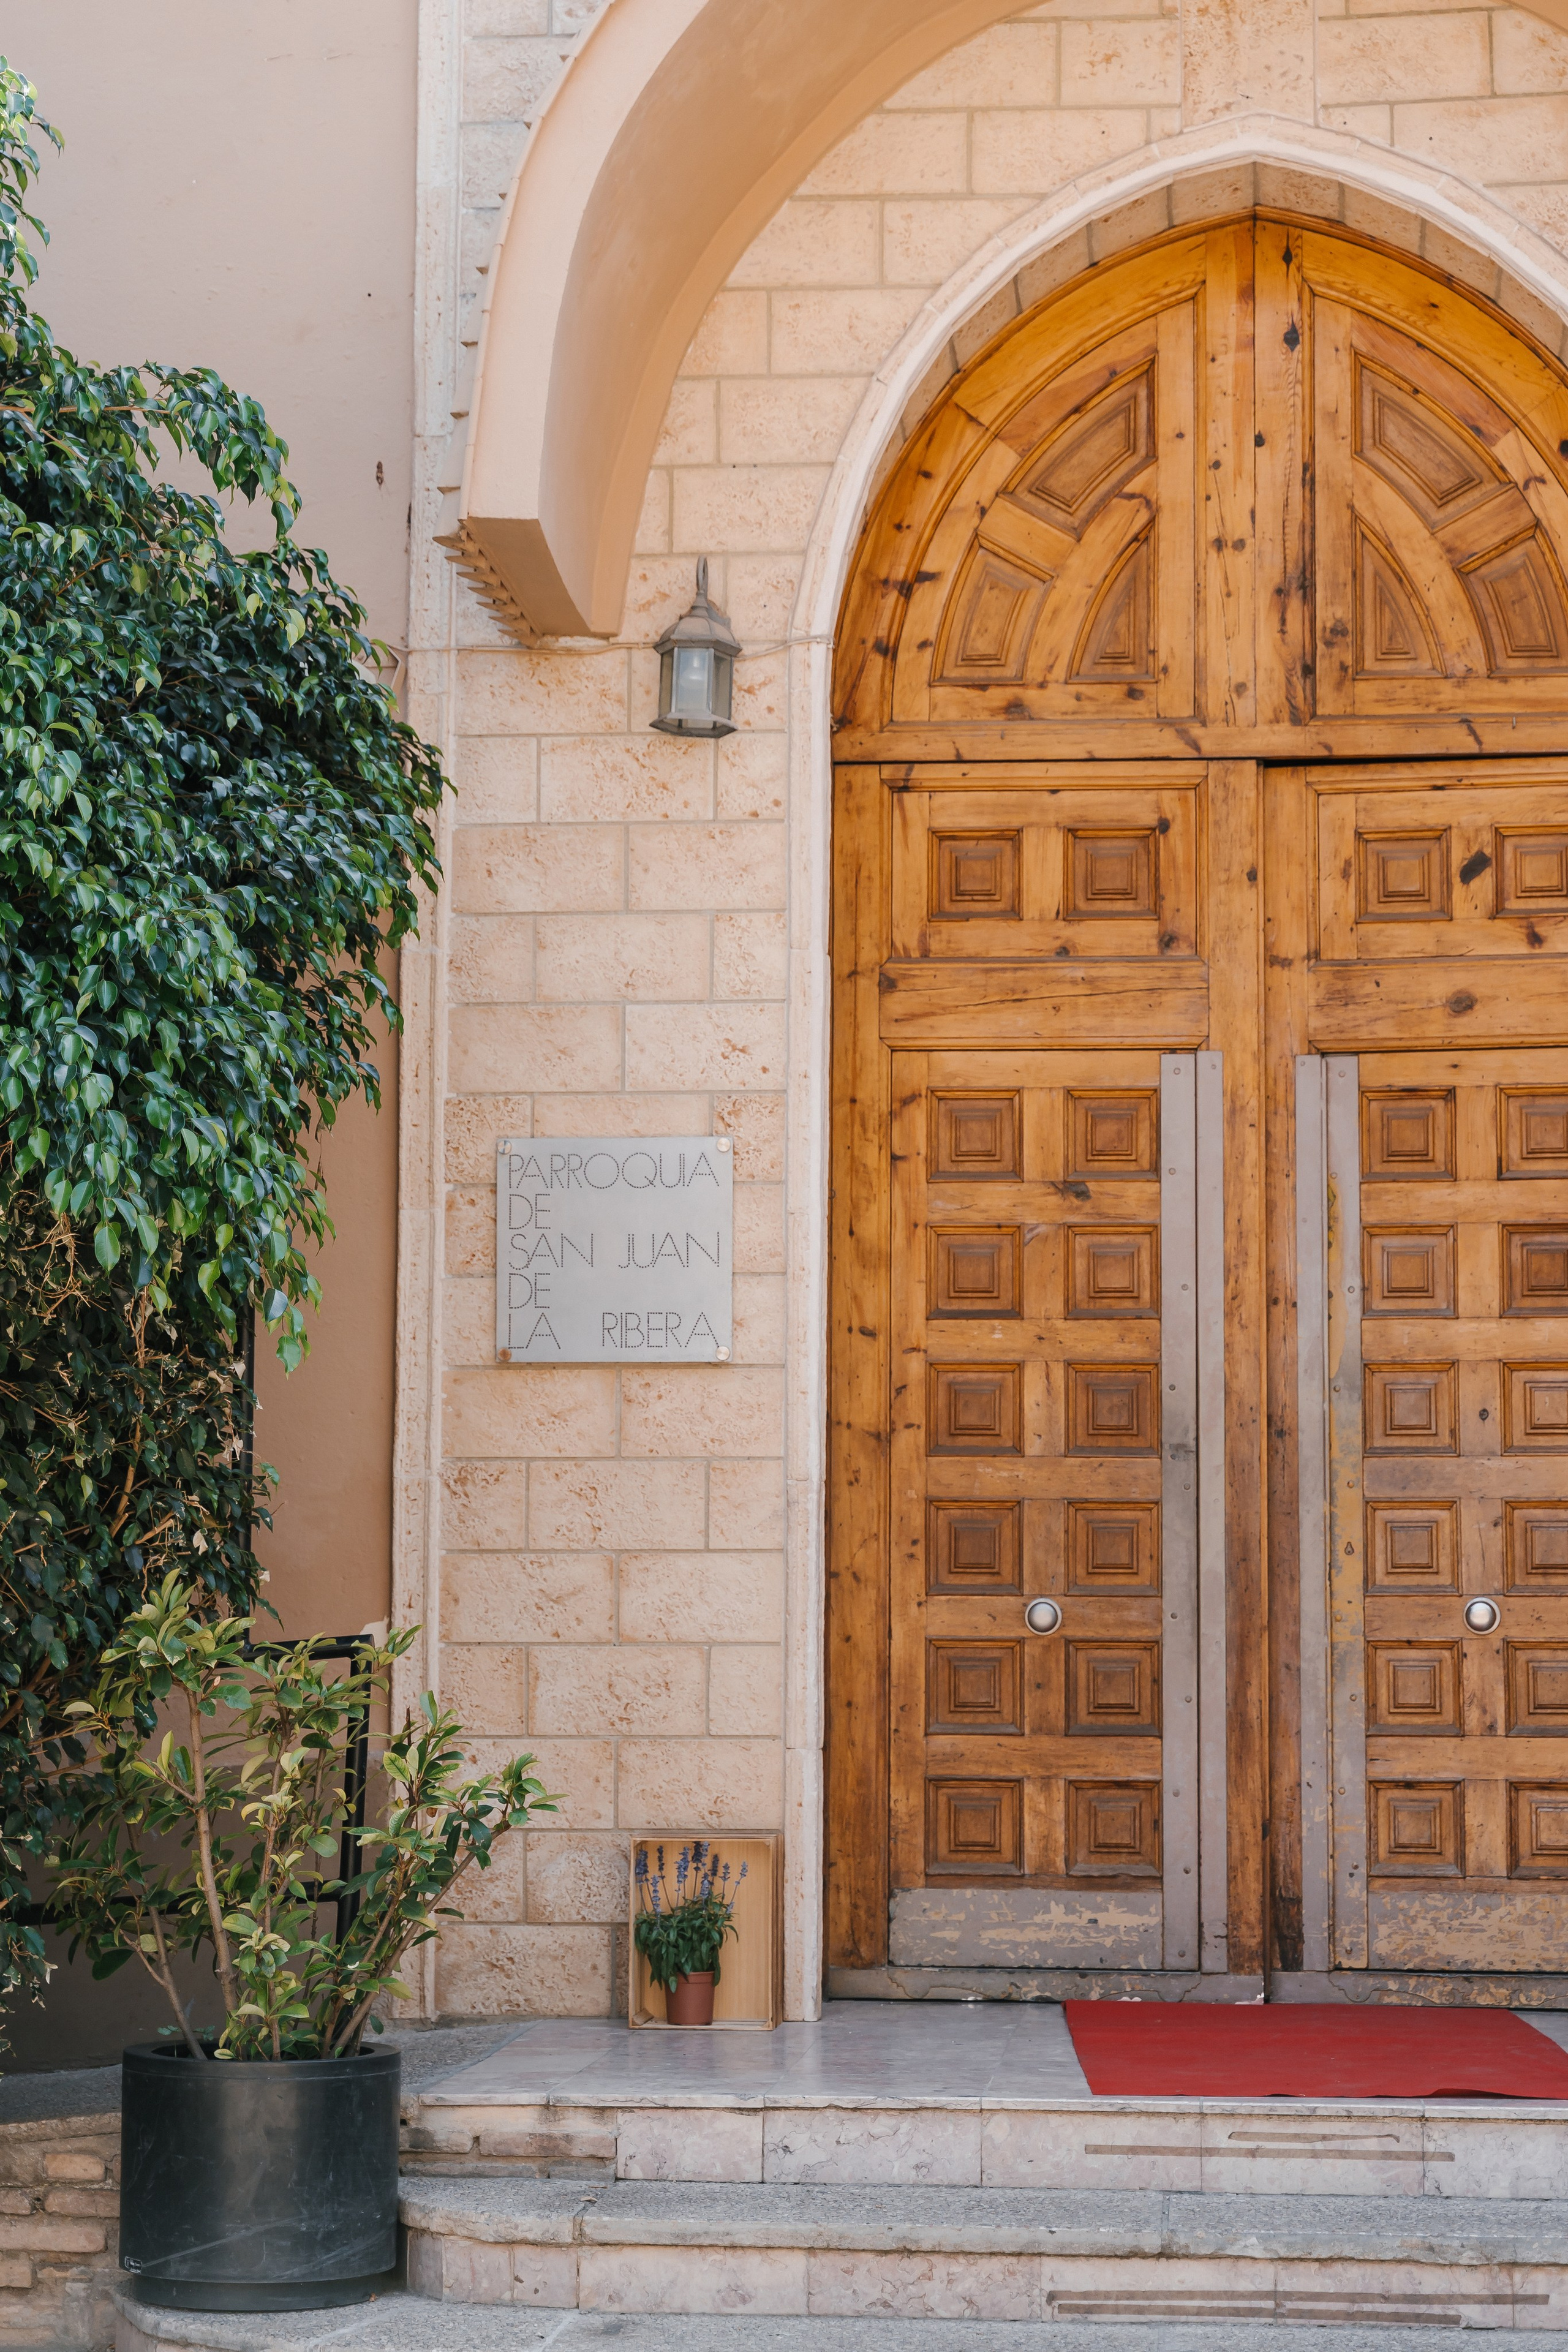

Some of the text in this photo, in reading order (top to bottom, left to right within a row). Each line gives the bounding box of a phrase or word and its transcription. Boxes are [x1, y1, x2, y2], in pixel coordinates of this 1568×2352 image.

[509, 1152, 719, 1189] PARROQUIA
[509, 1193, 551, 1229] DE
[509, 1232, 719, 1270] SAN JUAN
[508, 1273, 550, 1309] DE
[508, 1312, 720, 1349] LA RIBERA
